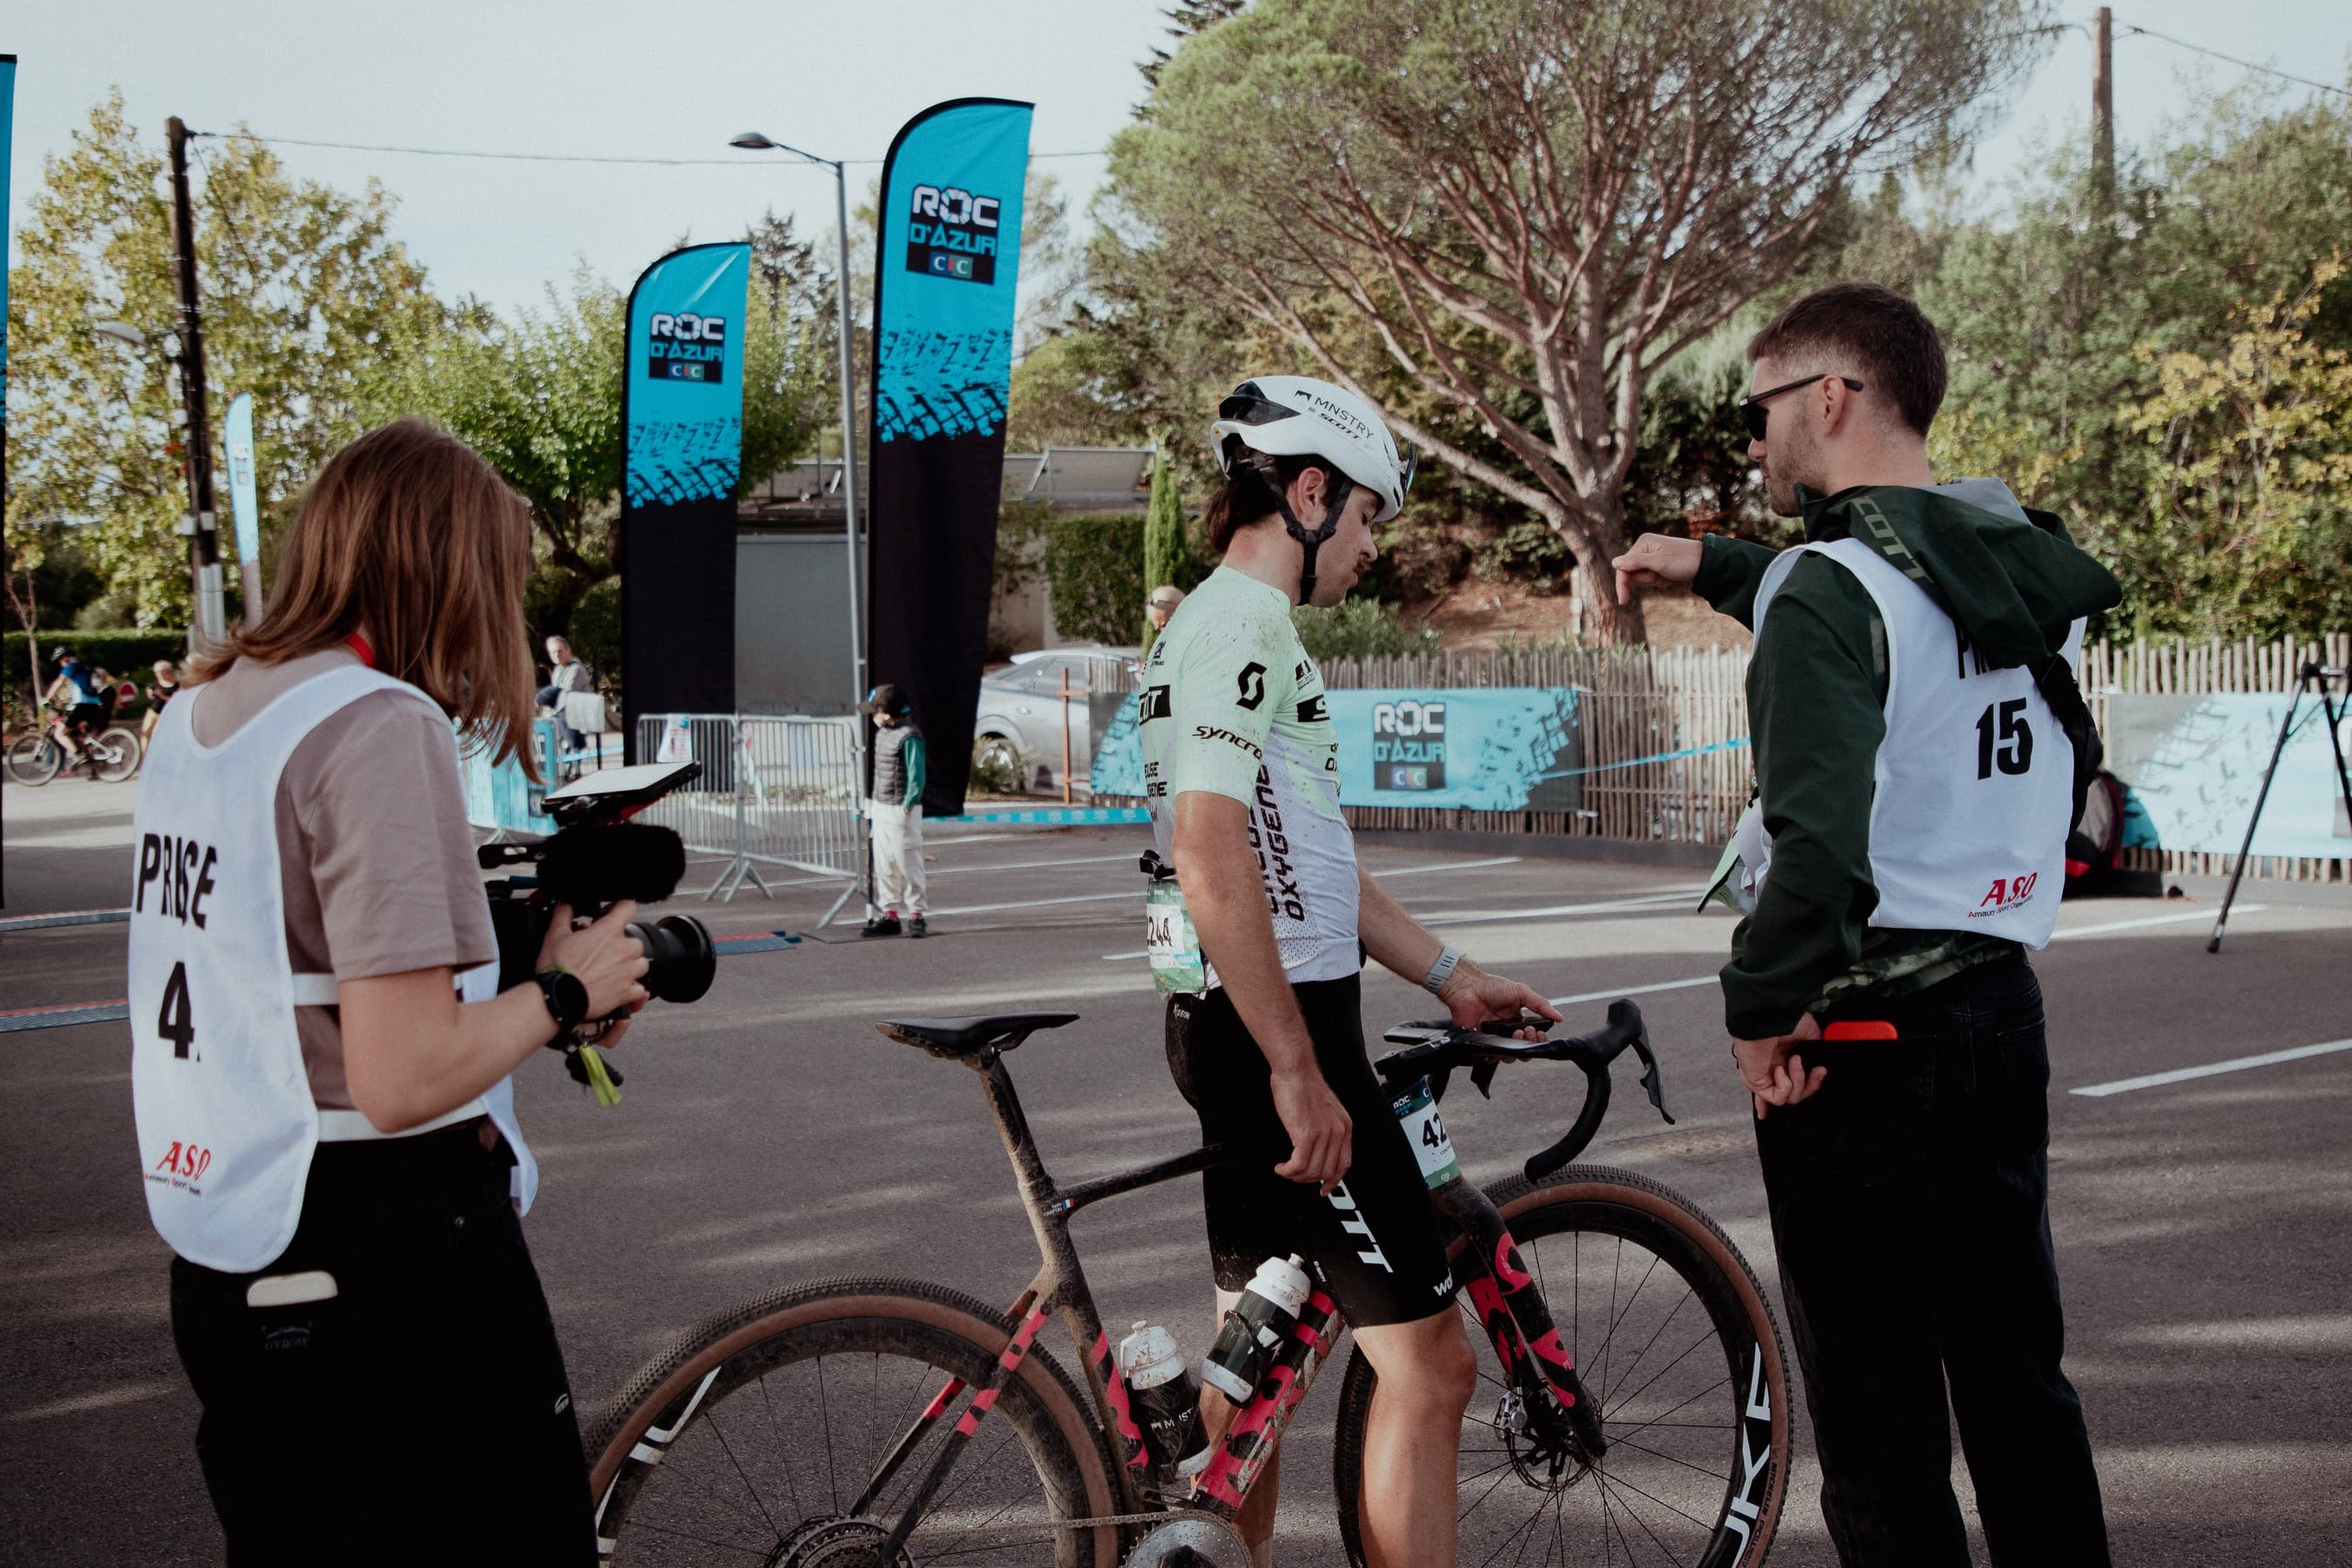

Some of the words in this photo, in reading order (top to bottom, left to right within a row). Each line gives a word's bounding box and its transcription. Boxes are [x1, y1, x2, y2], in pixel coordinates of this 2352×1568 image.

[912, 186, 999, 228] ROC
[909, 222, 997, 257] D'AZUR
[933, 256, 969, 274] CIC
[651, 314, 725, 341] ROC
[650, 341, 723, 362] D'AZUR
[672, 365, 700, 378] CIC
[1315, 397, 1375, 439] MNSTRY
[1318, 413, 1361, 439] SCOTT
[1374, 700, 1445, 737] ROC
[1375, 738, 1445, 763] D'AZUR
[1975, 697, 2034, 781] 15
[1395, 771, 1423, 786] CIC
